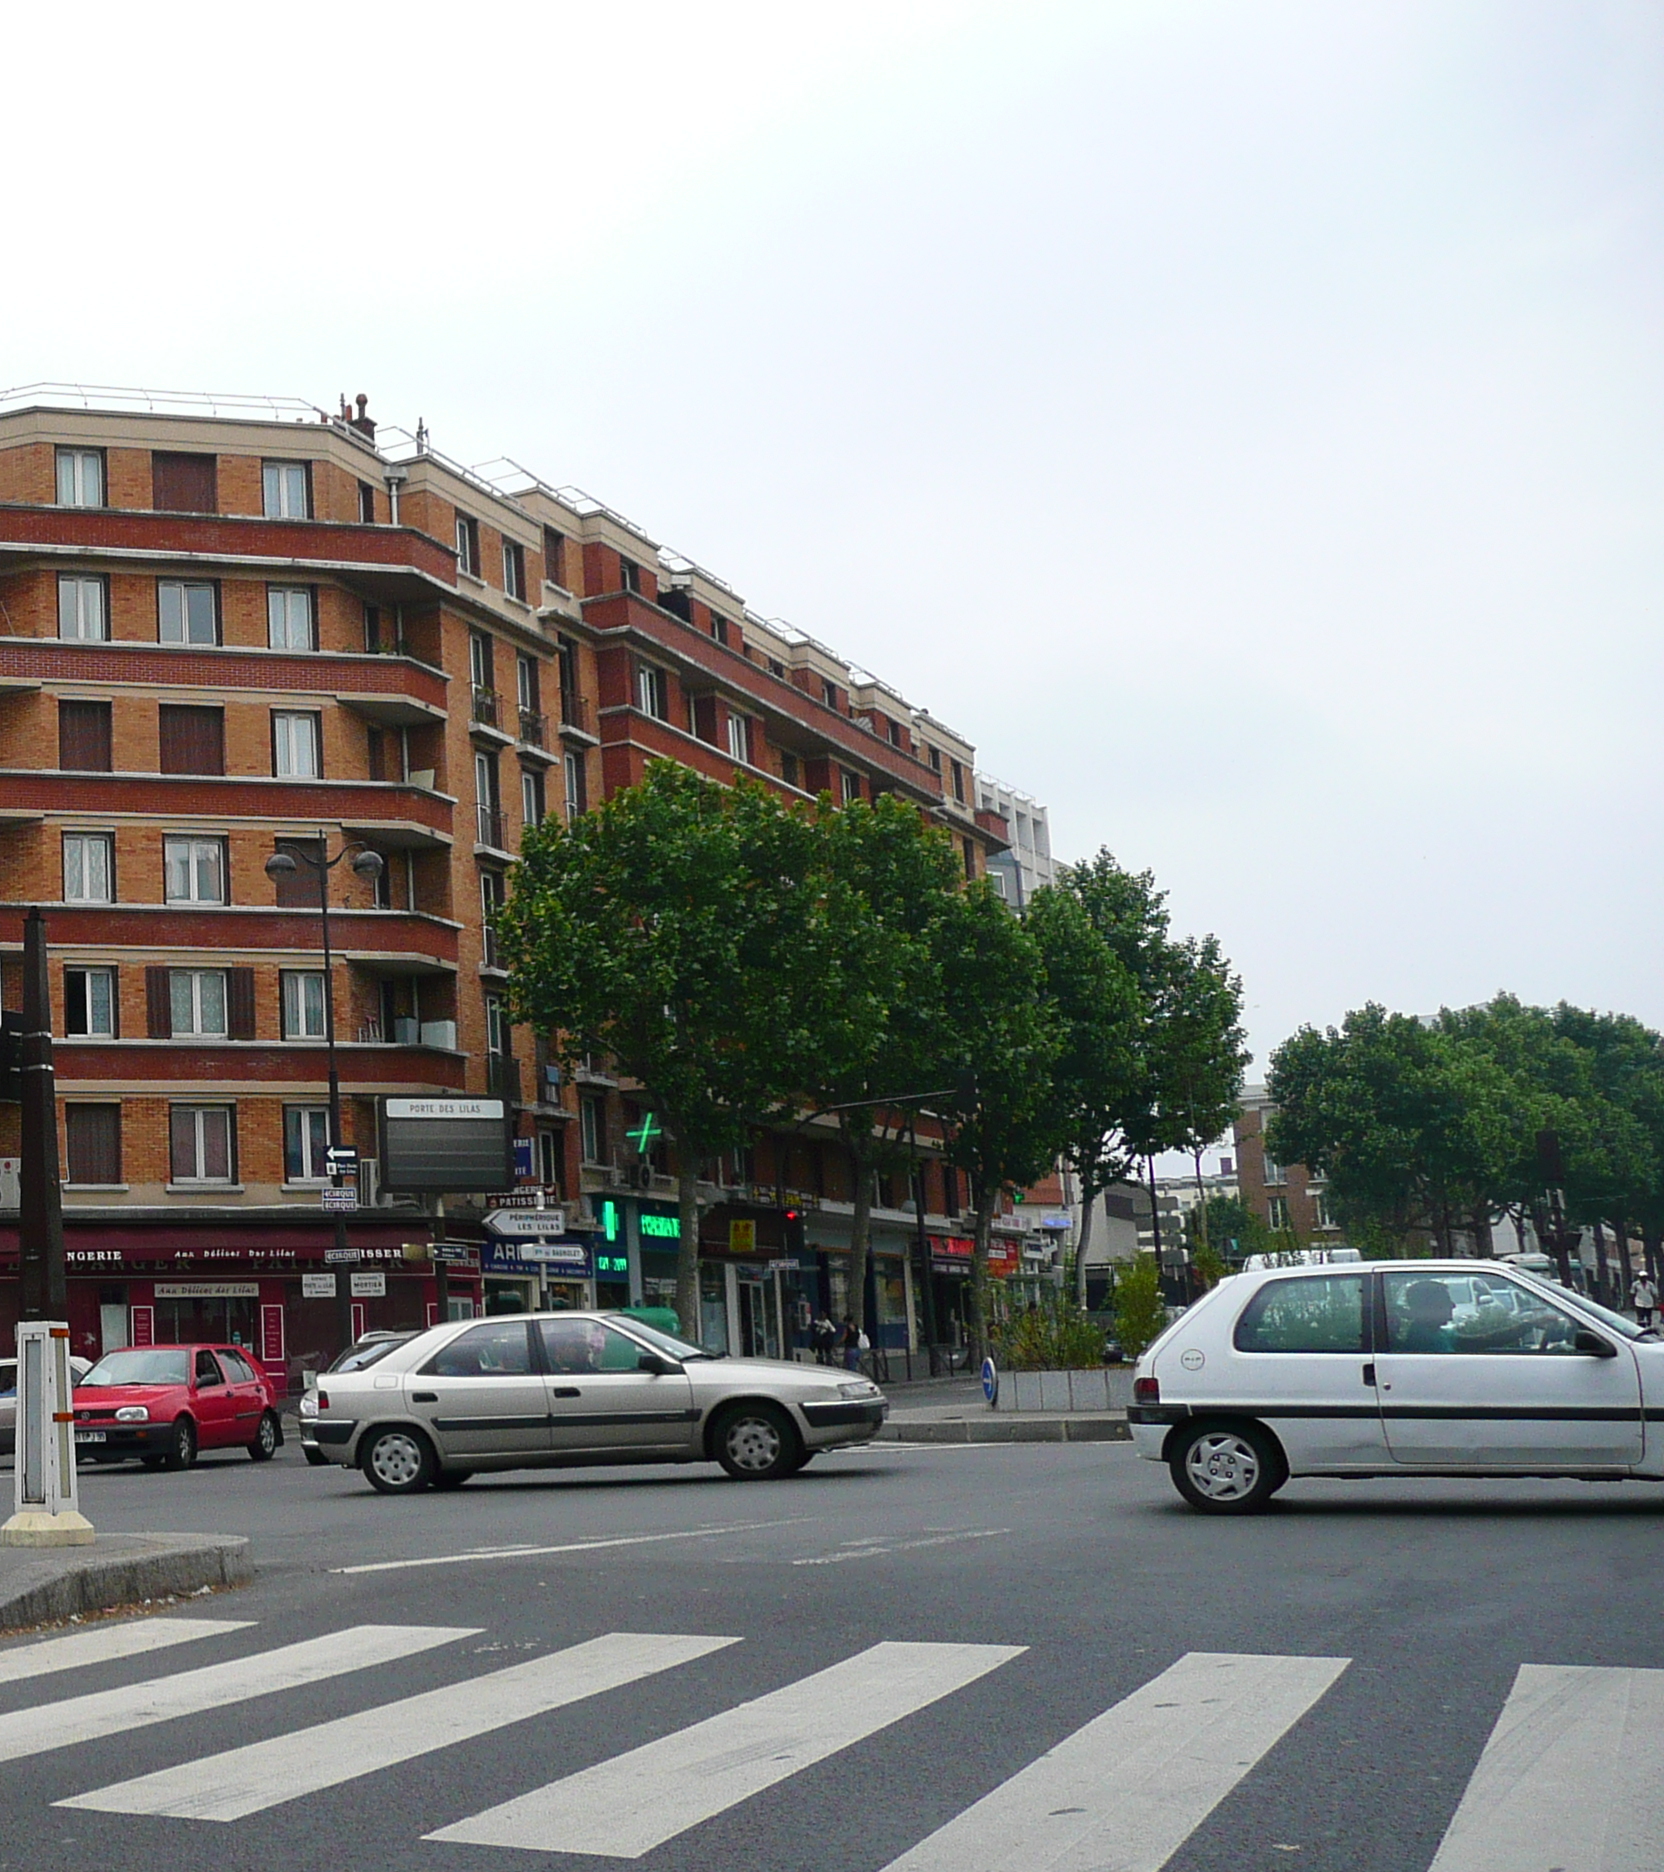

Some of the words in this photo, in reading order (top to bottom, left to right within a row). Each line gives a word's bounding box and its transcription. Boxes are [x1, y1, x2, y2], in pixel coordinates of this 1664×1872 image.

[409, 1104, 434, 1113] PORTE
[439, 1104, 454, 1113] DES
[459, 1104, 481, 1113] LILAS
[517, 1223, 532, 1231] LES
[537, 1223, 560, 1231] LILAS
